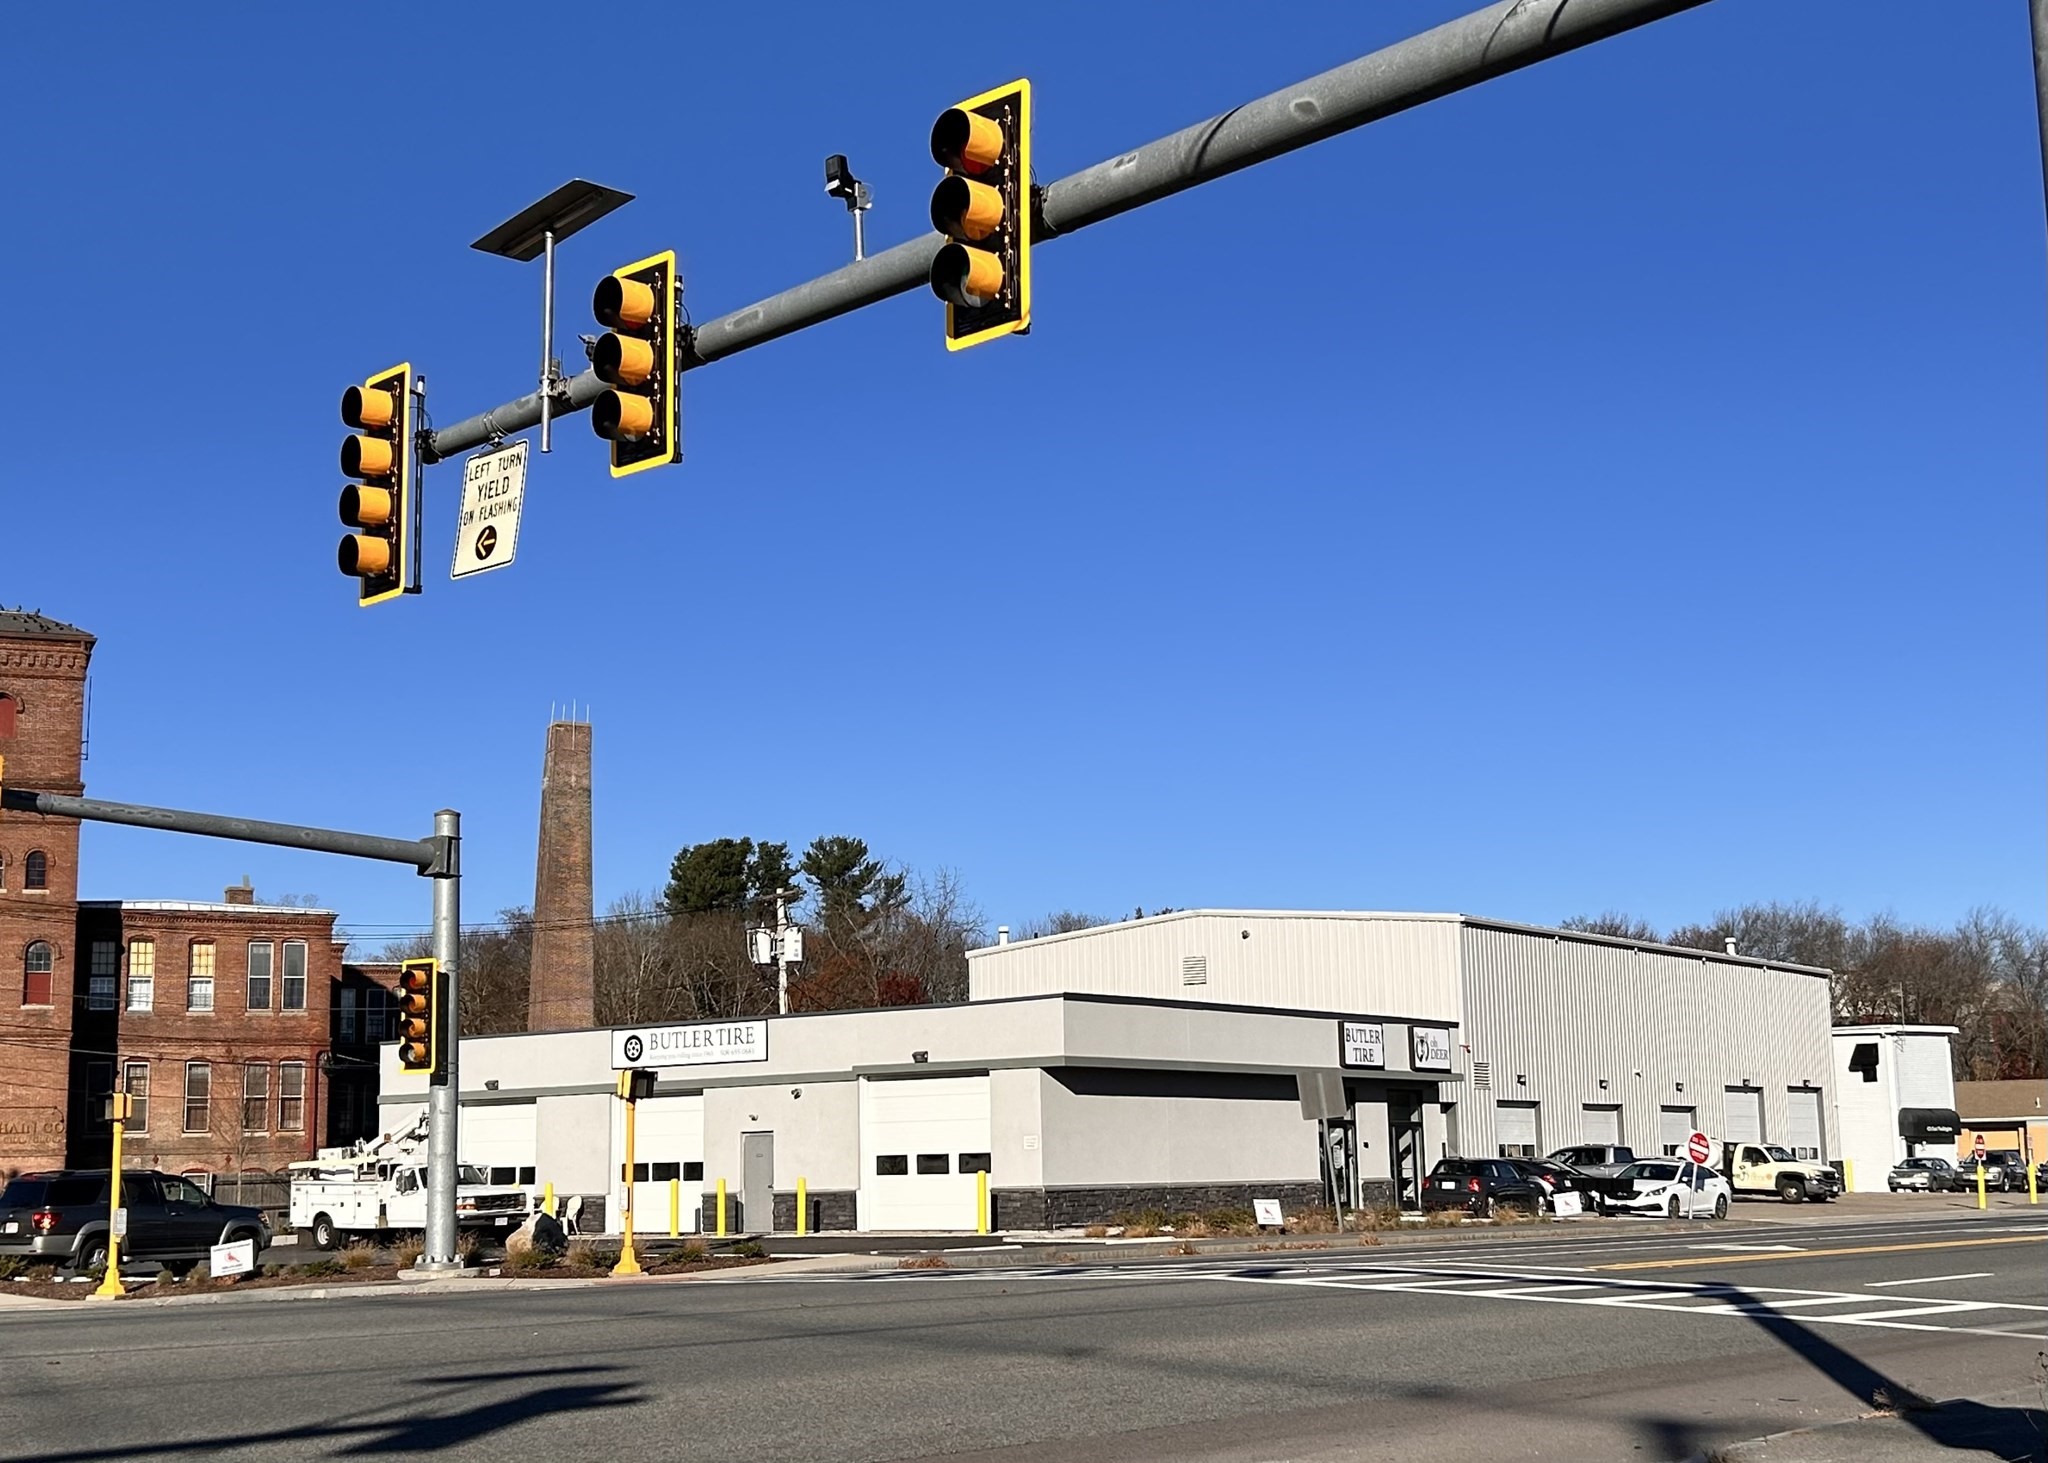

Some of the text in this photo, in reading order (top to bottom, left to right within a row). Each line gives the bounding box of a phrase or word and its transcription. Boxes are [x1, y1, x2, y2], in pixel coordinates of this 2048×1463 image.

[469, 451, 523, 482] LEFT TURN
[477, 476, 510, 502] YIELD
[463, 496, 518, 526] ON FLASHING
[650, 1026, 755, 1051] BUTLER TIRE
[1345, 1027, 1381, 1044] BUTLER
[1430, 1036, 1438, 1048] oh
[1353, 1047, 1375, 1063] TIRE
[1430, 1048, 1449, 1060] DEER
